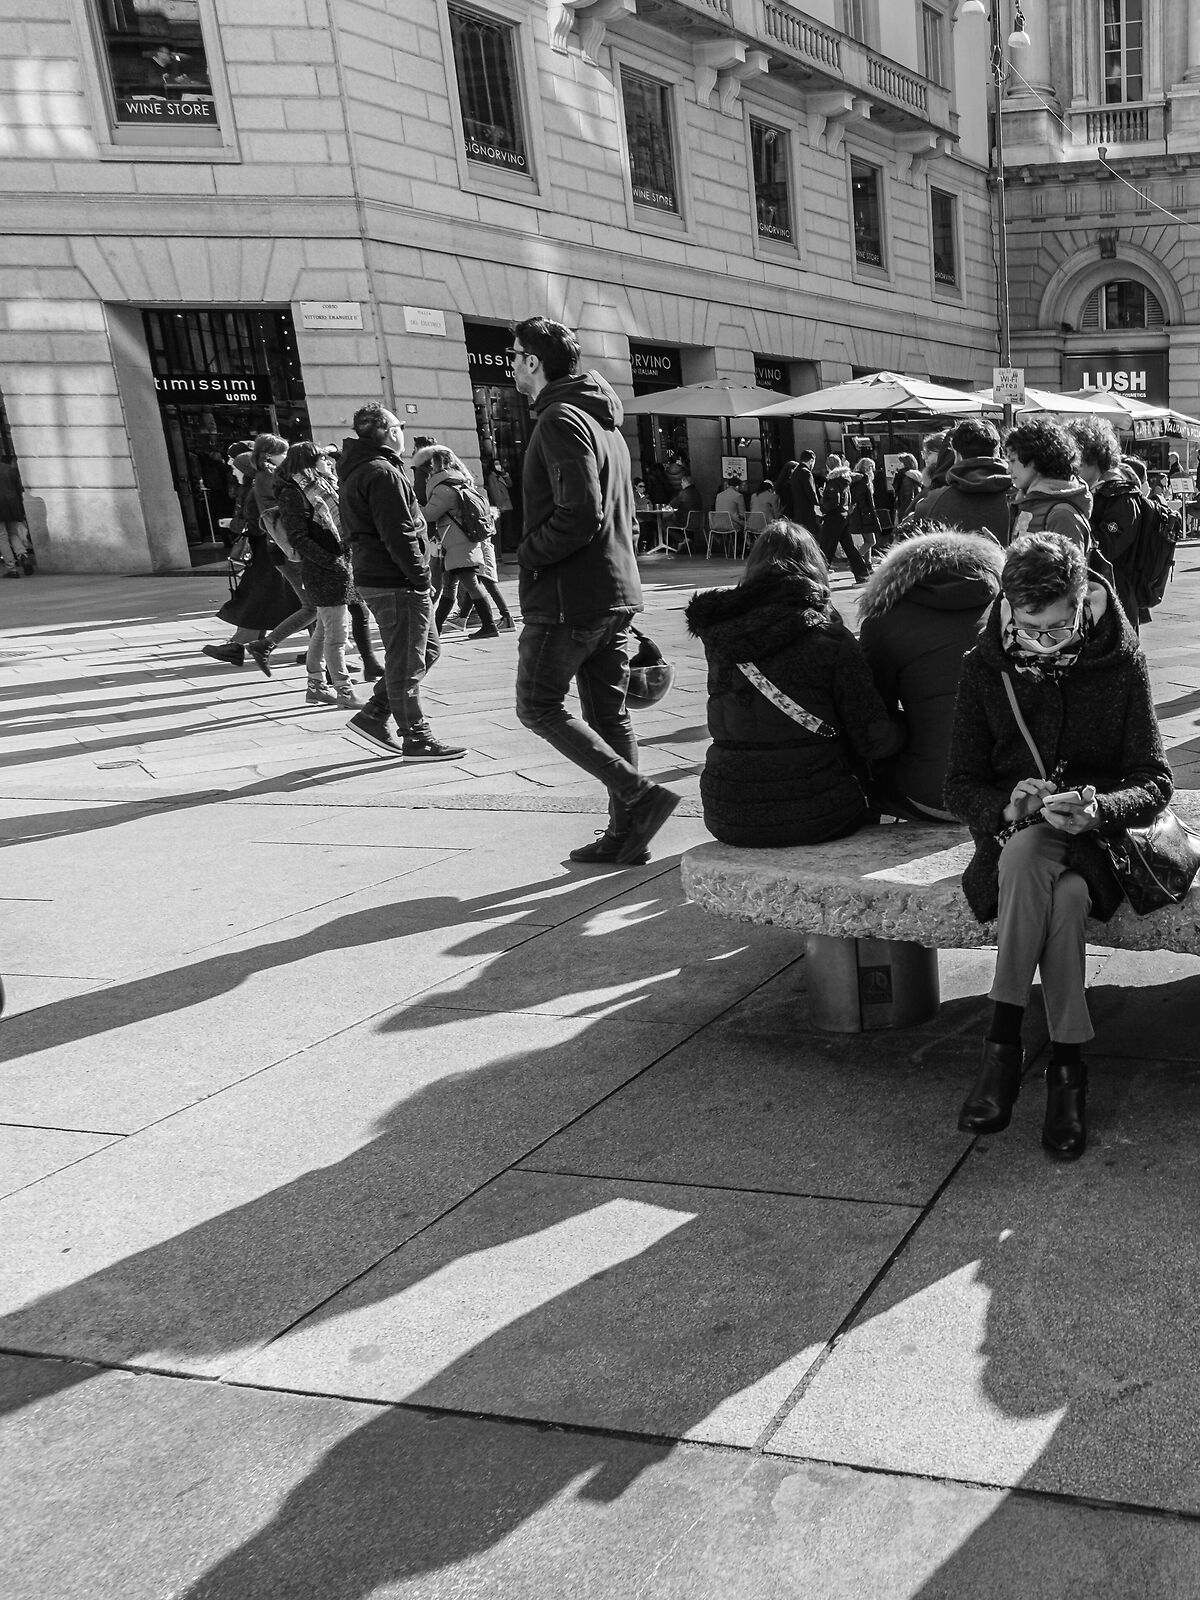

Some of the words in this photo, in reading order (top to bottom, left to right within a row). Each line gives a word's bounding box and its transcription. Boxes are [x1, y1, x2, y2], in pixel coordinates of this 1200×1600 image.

[126, 102, 162, 114] WINE
[167, 103, 210, 116] STORE
[464, 141, 525, 166] SIGNORVINO
[633, 188, 651, 201] WINE
[652, 192, 673, 207] STORE
[420, 319, 441, 329] DUOMO
[154, 377, 256, 390] timissimi
[1083, 371, 1146, 391] LUSH
[225, 393, 257, 401] uomo
